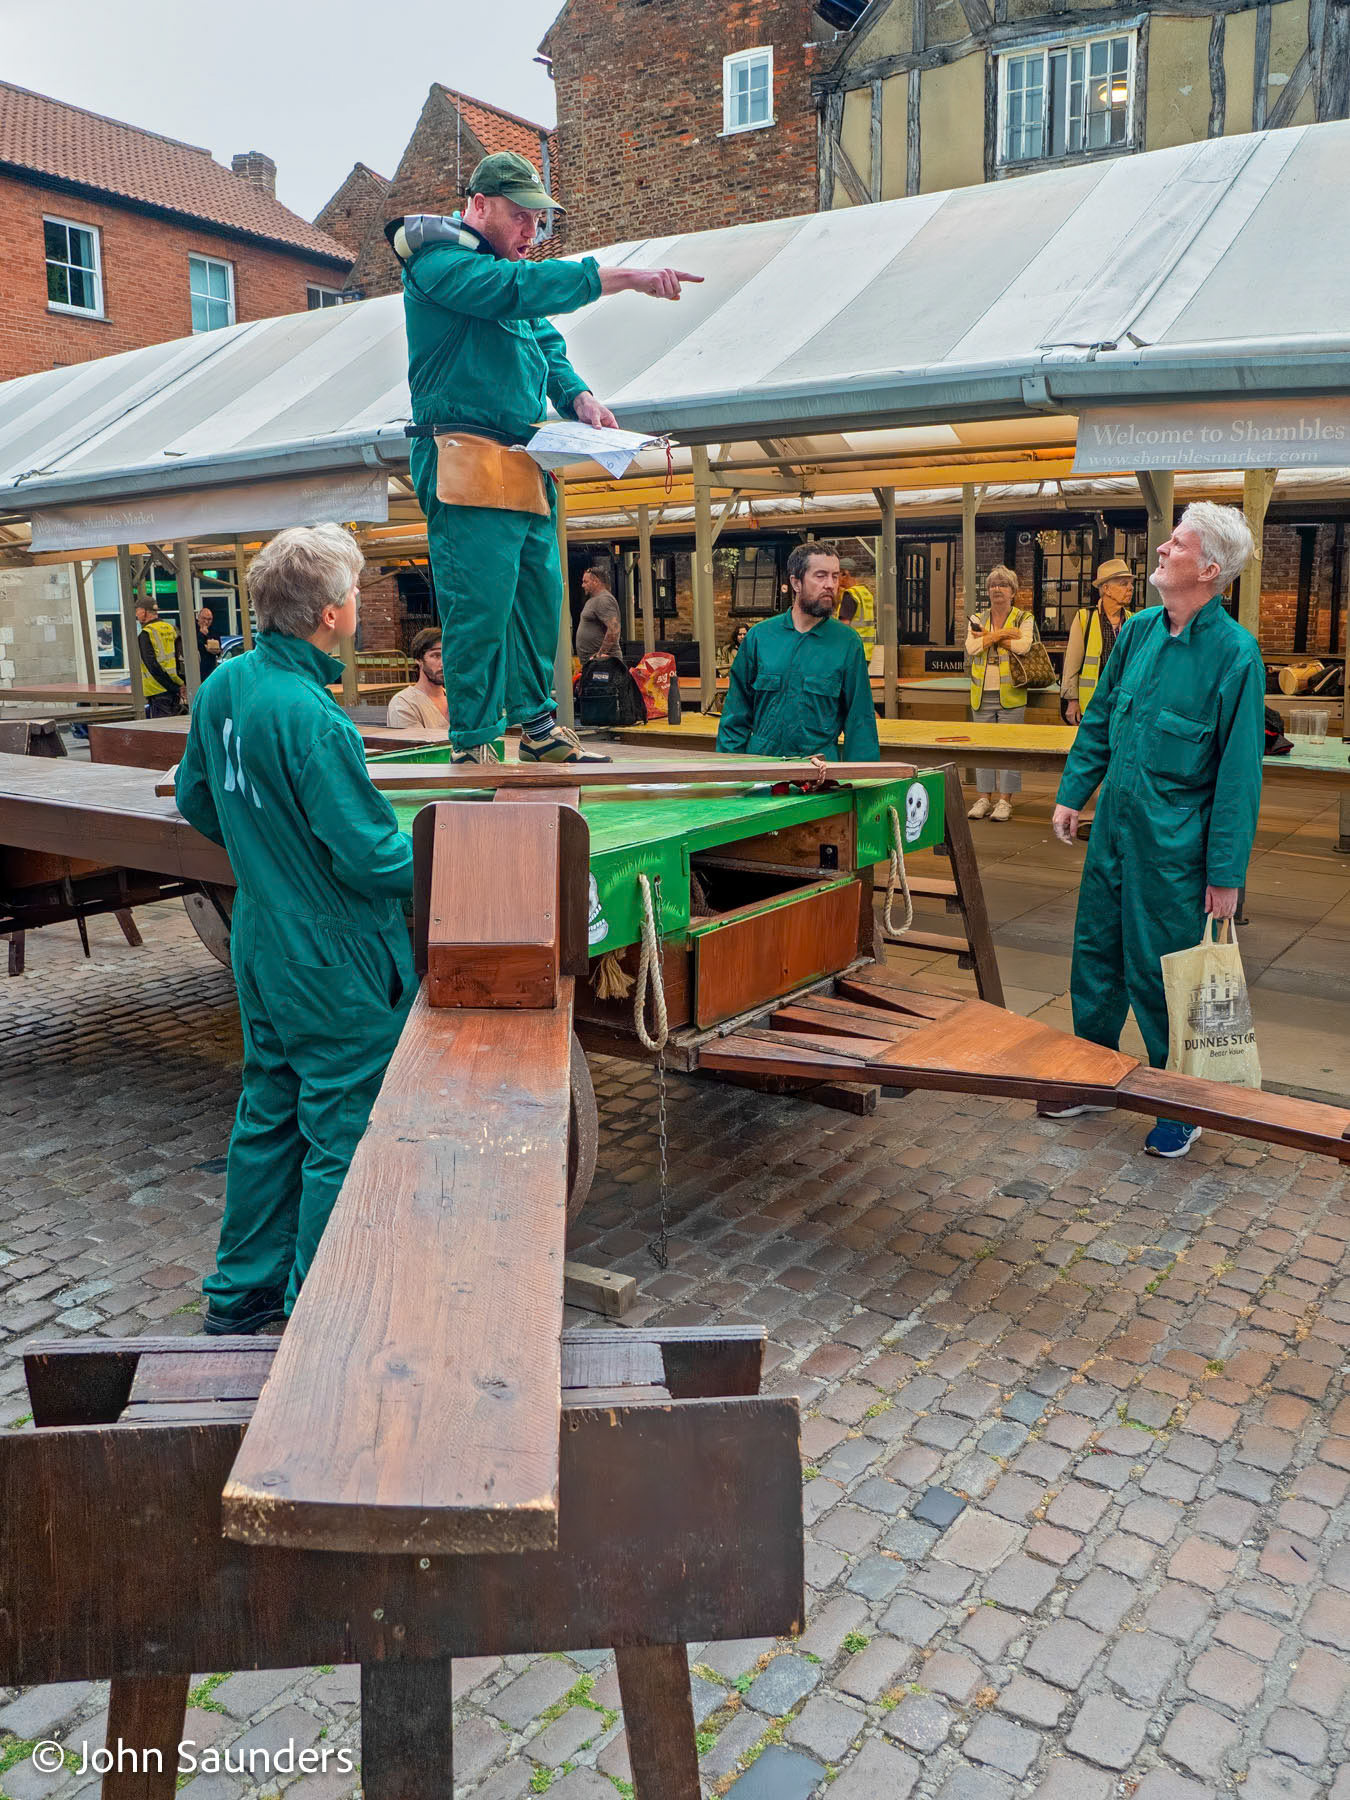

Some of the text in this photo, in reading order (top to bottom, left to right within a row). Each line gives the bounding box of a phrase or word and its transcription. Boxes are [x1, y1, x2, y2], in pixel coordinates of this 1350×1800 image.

[1092, 417, 1345, 446] Welcome to Shambles
[1088, 448, 1319, 466] www.shamblesmarket.com
[1184, 1036, 1229, 1051] DUNNES
